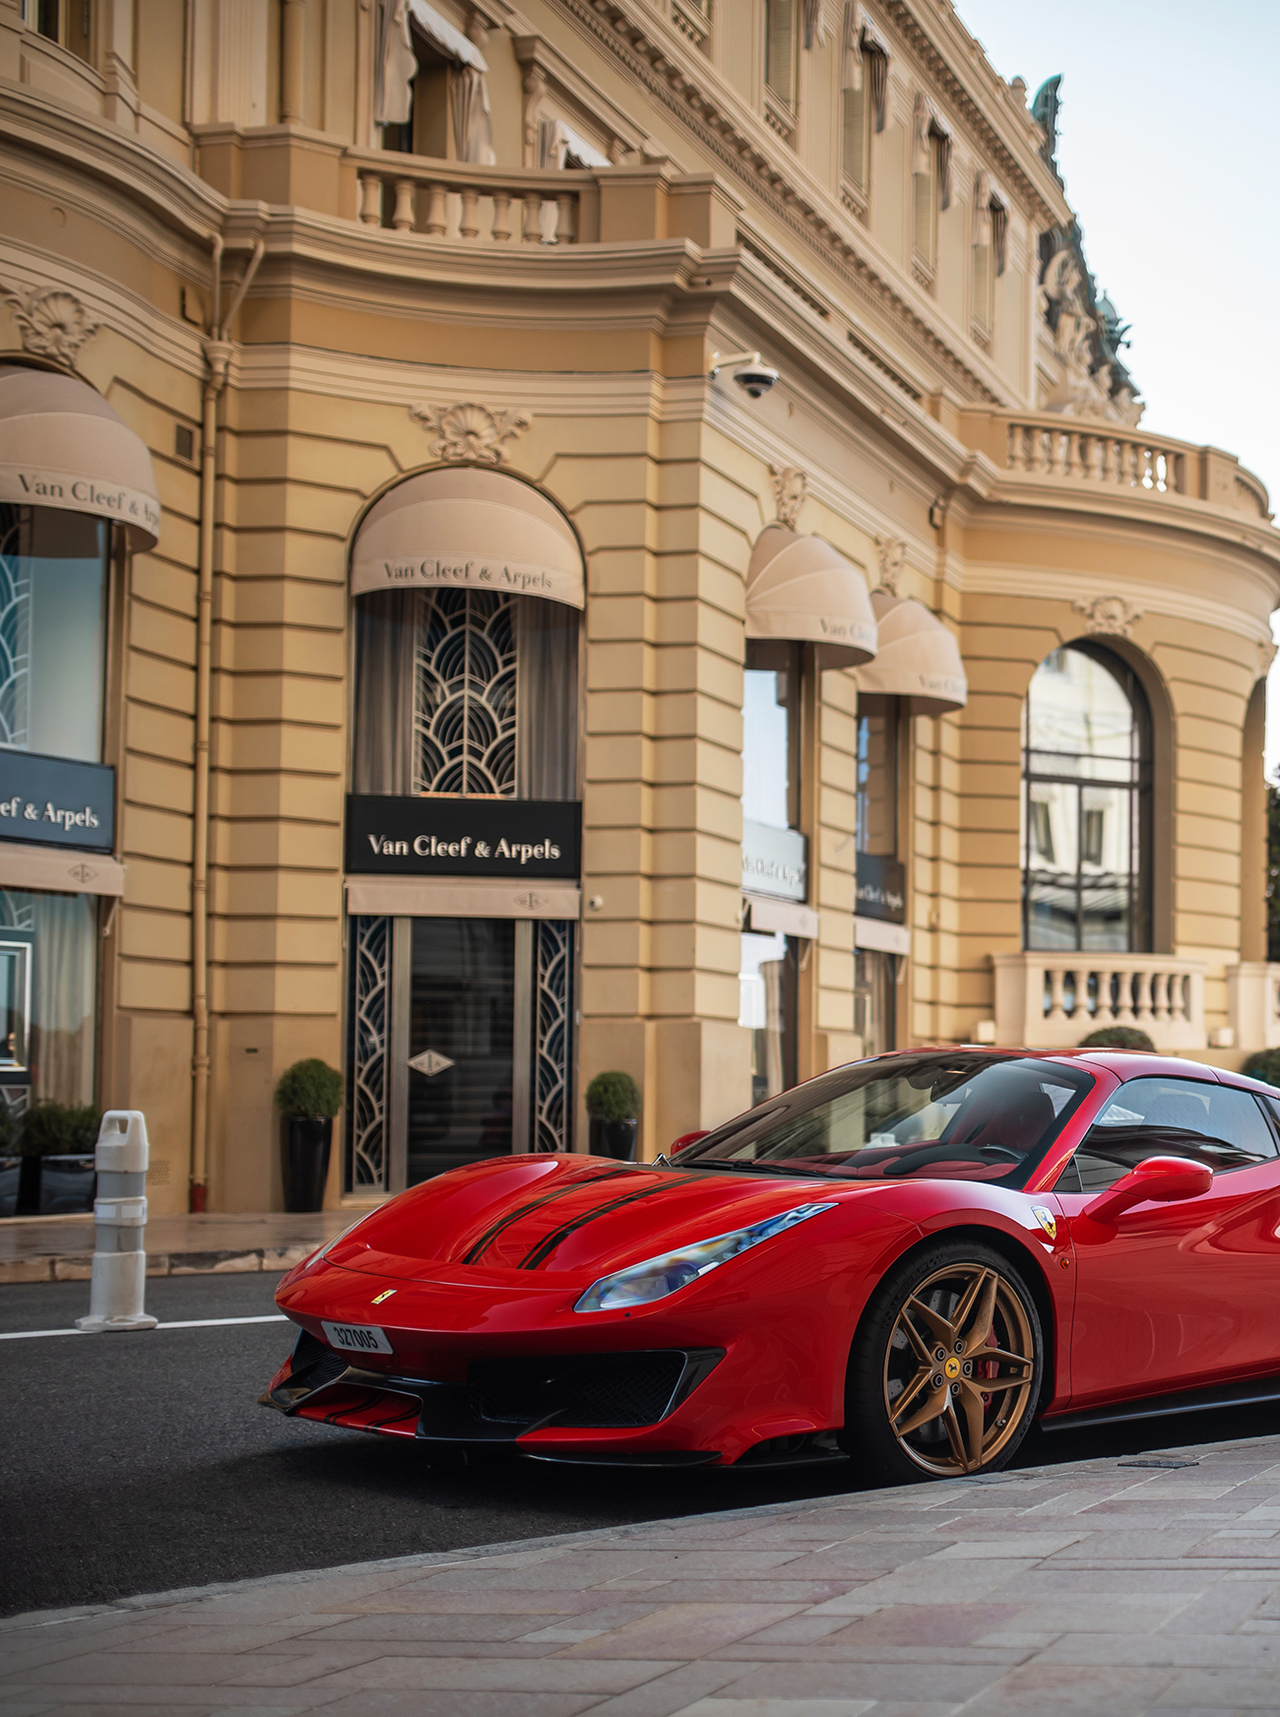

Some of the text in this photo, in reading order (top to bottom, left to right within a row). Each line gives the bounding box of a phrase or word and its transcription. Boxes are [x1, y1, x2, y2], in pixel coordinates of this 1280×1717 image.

[17, 473, 64, 498] Van
[71, 480, 126, 510] Cleef
[129, 500, 138, 516] &
[384, 558, 553, 590] Van Cleef & Arpels
[24, 802, 38, 821] &
[42, 801, 99, 831] Arpels
[368, 834, 561, 865] Van Cleef & Arpels
[333, 1326, 379, 1349] 327005
